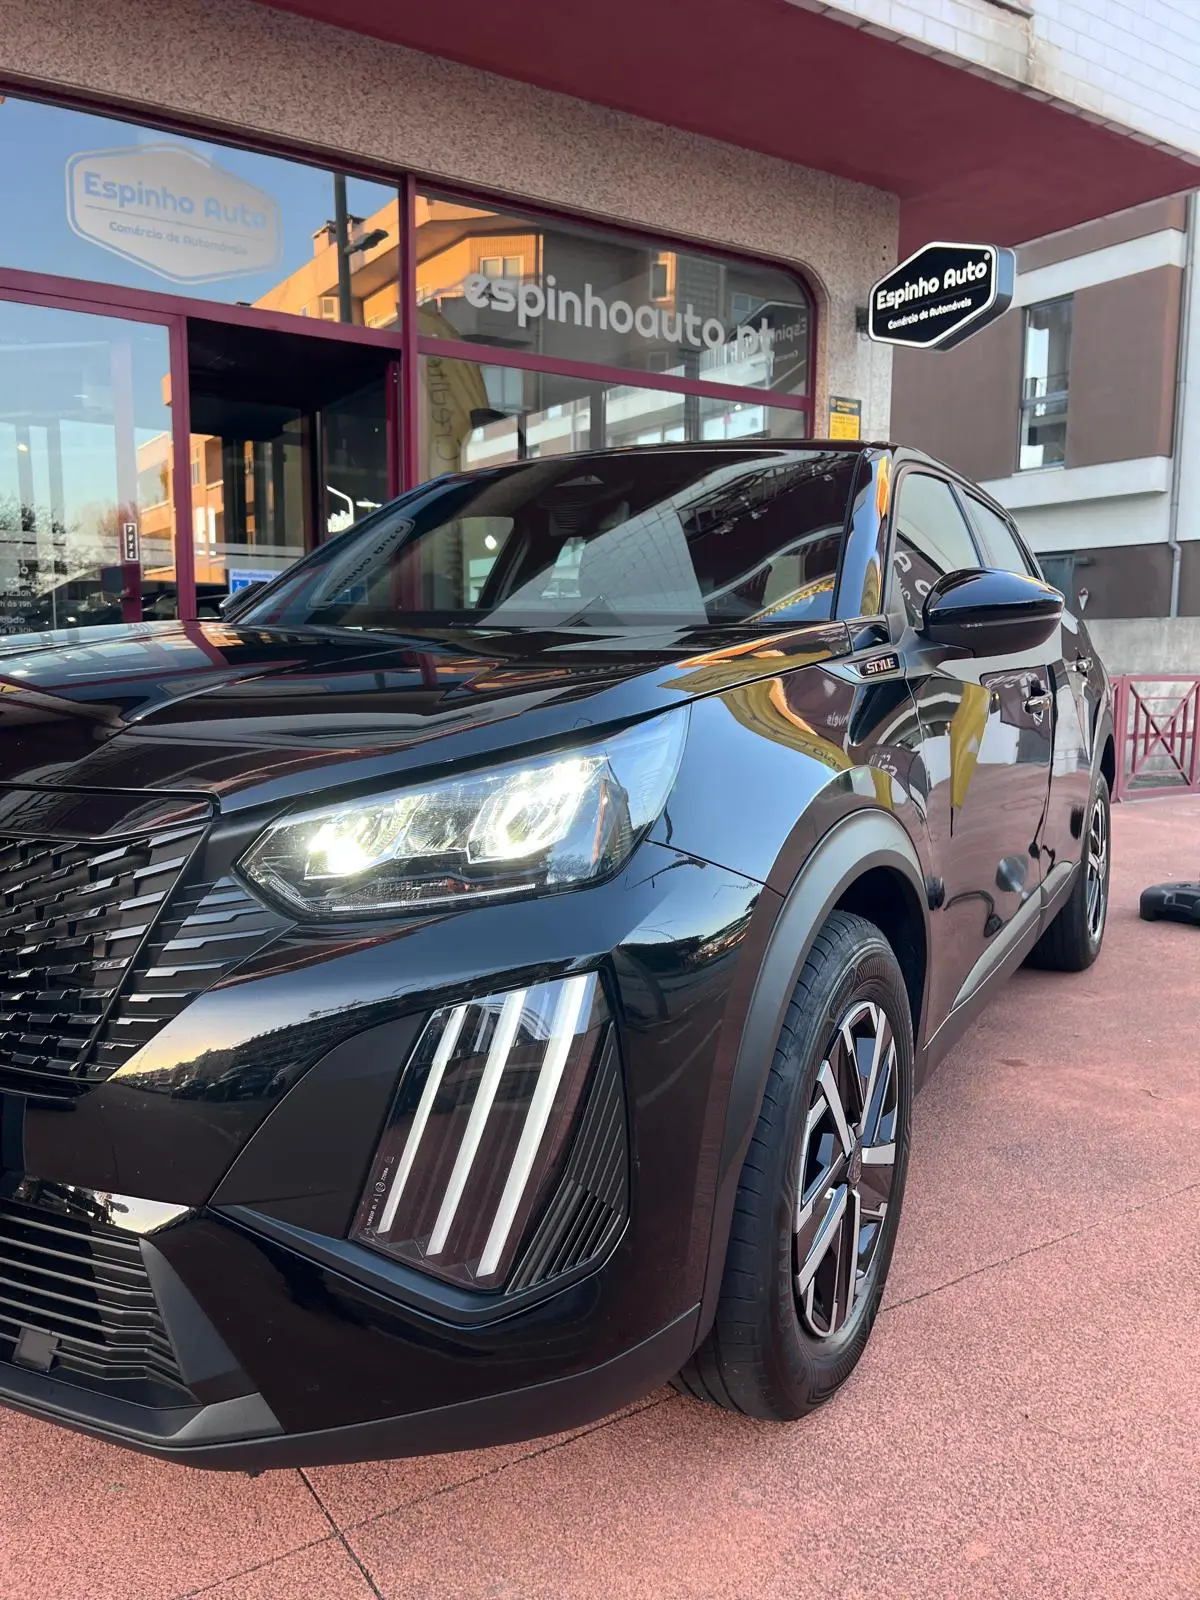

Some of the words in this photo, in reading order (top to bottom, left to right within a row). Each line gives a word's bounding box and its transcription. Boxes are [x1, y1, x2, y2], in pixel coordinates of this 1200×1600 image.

[84, 171, 195, 215] Espinho
[204, 196, 267, 229] Auto
[876, 277, 940, 311] Espinho
[943, 261, 988, 289] Auto
[887, 312, 919, 330] Comércio
[919, 309, 929, 321] de
[929, 297, 972, 318] Automóveis
[866, 657, 896, 674] STYLE
